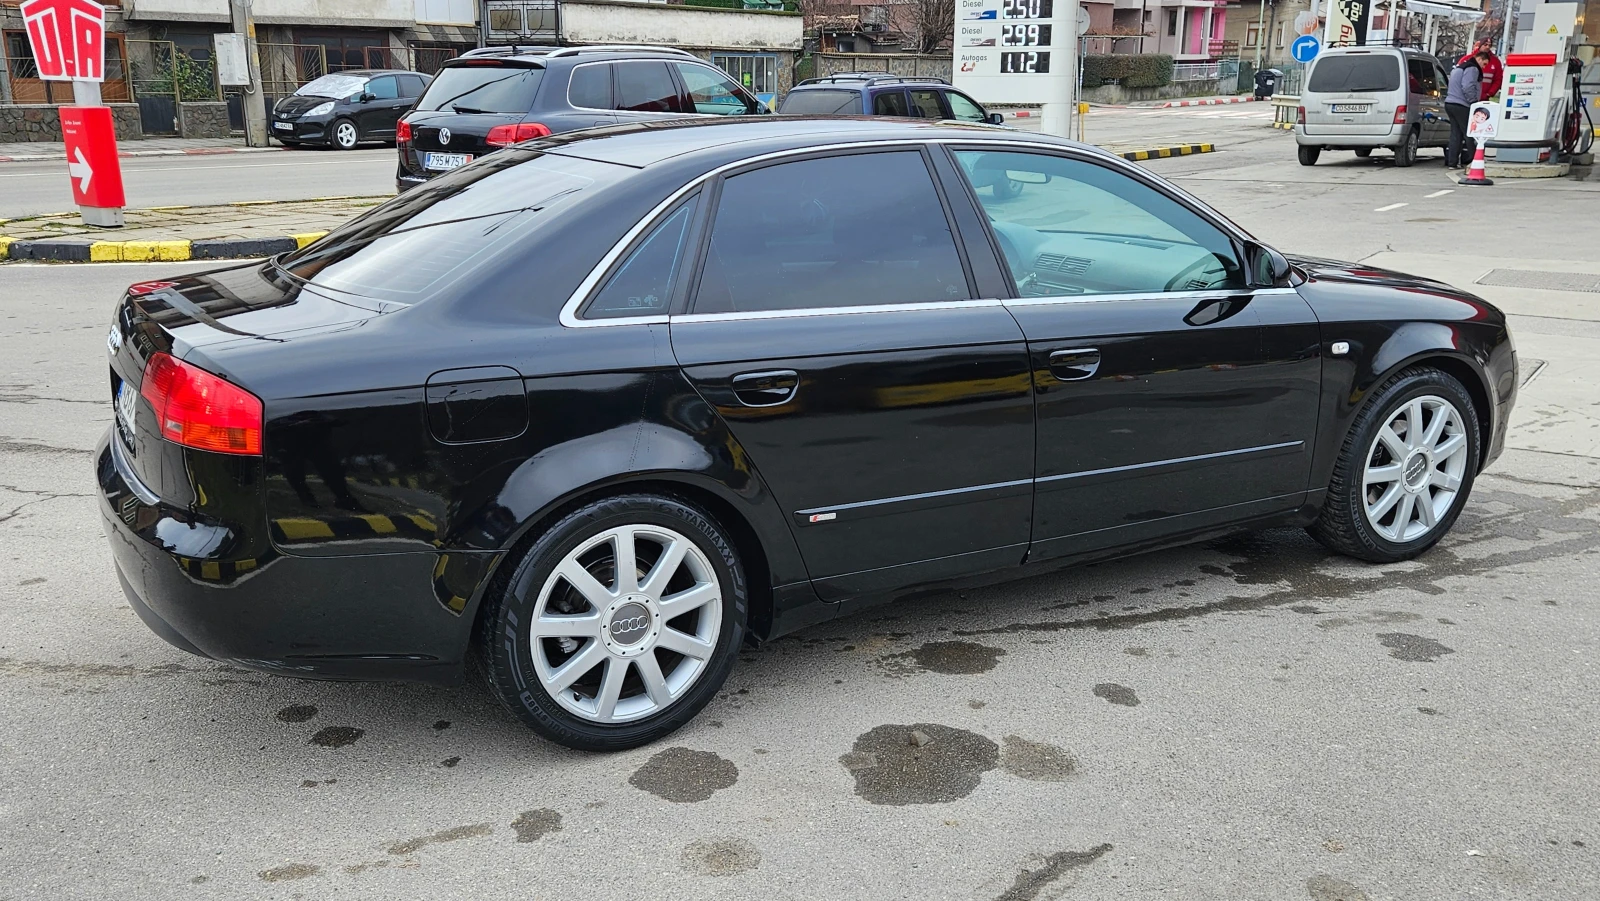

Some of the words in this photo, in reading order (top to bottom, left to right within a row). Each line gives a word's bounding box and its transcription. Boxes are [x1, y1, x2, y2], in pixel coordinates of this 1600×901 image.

[1003, 0, 1040, 19] 2.50
[1350, 1, 1360, 22] 100
[961, 27, 983, 35] Diesel
[1002, 24, 1039, 46] 2.99
[961, 54, 988, 62] Autogas
[1007, 51, 1038, 73] 1.12
[676, 507, 733, 563] STARMAXX
